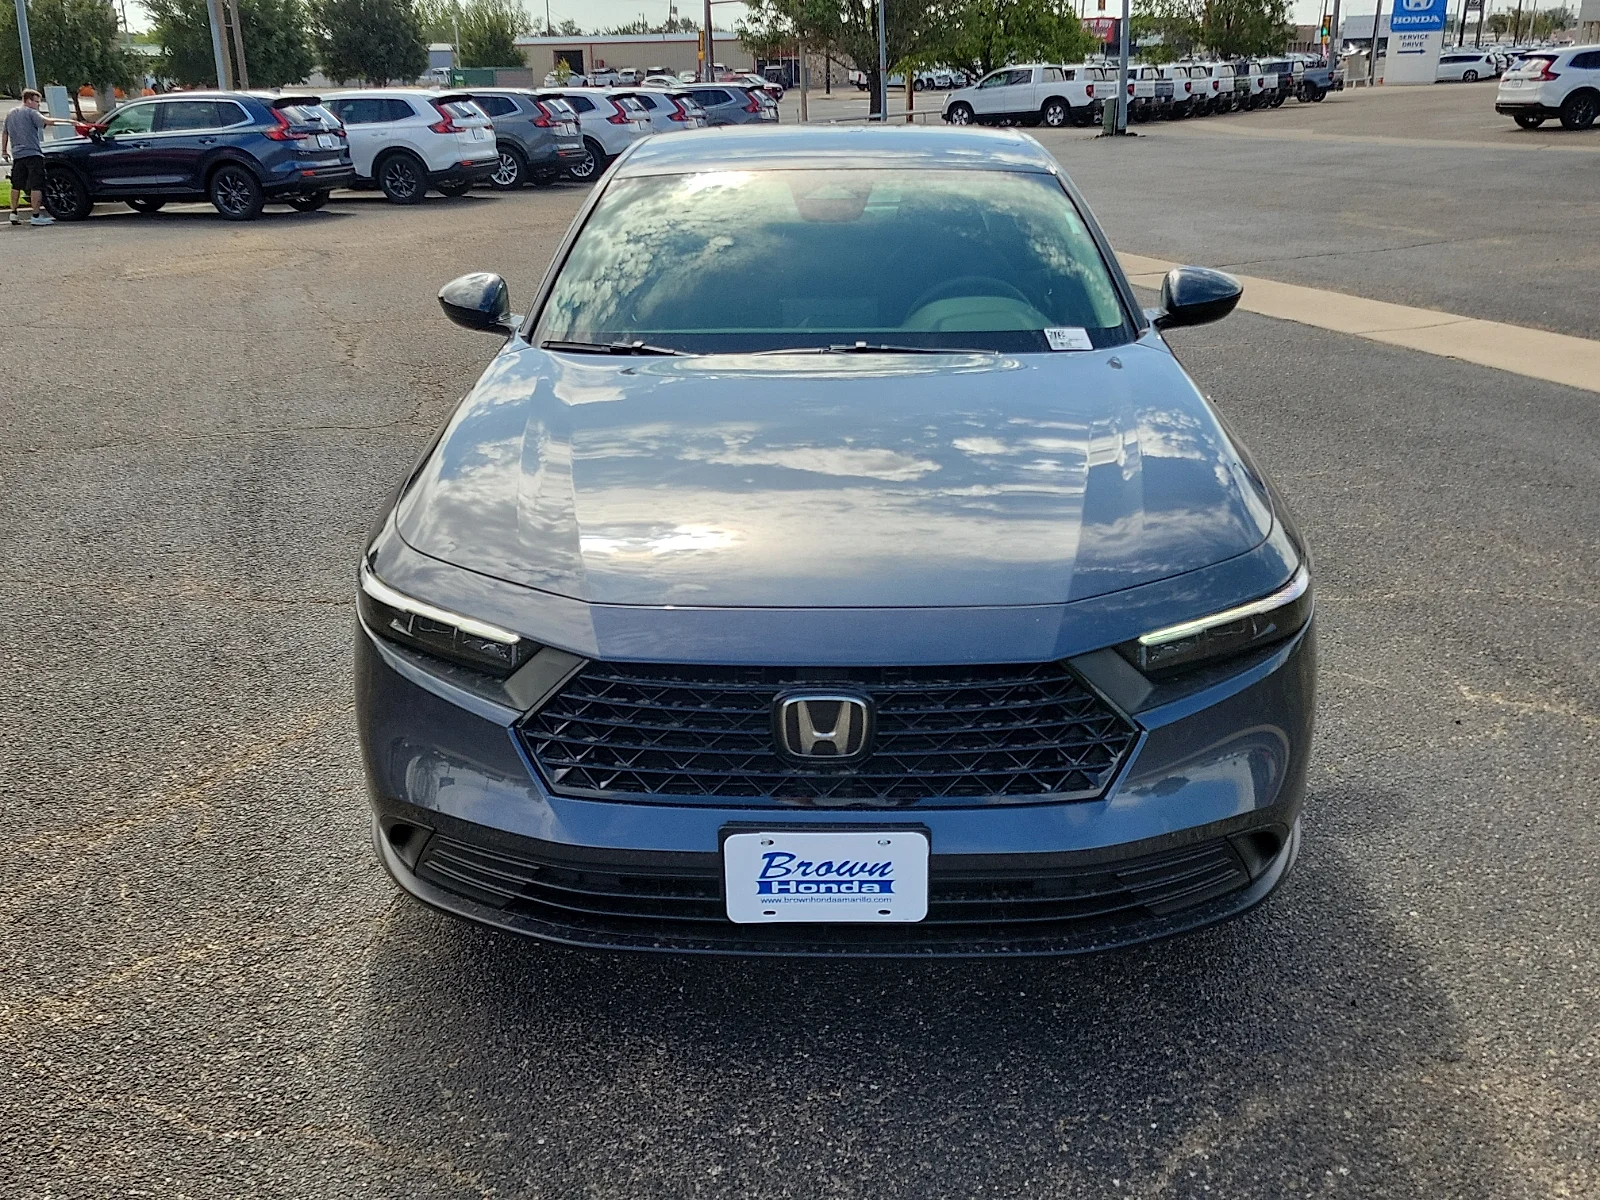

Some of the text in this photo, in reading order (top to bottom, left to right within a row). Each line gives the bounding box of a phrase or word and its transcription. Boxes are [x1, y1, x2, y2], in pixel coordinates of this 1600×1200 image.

[1392, 15, 1440, 24] HONDA
[759, 852, 894, 879] Brown
[771, 880, 881, 894] Honda
